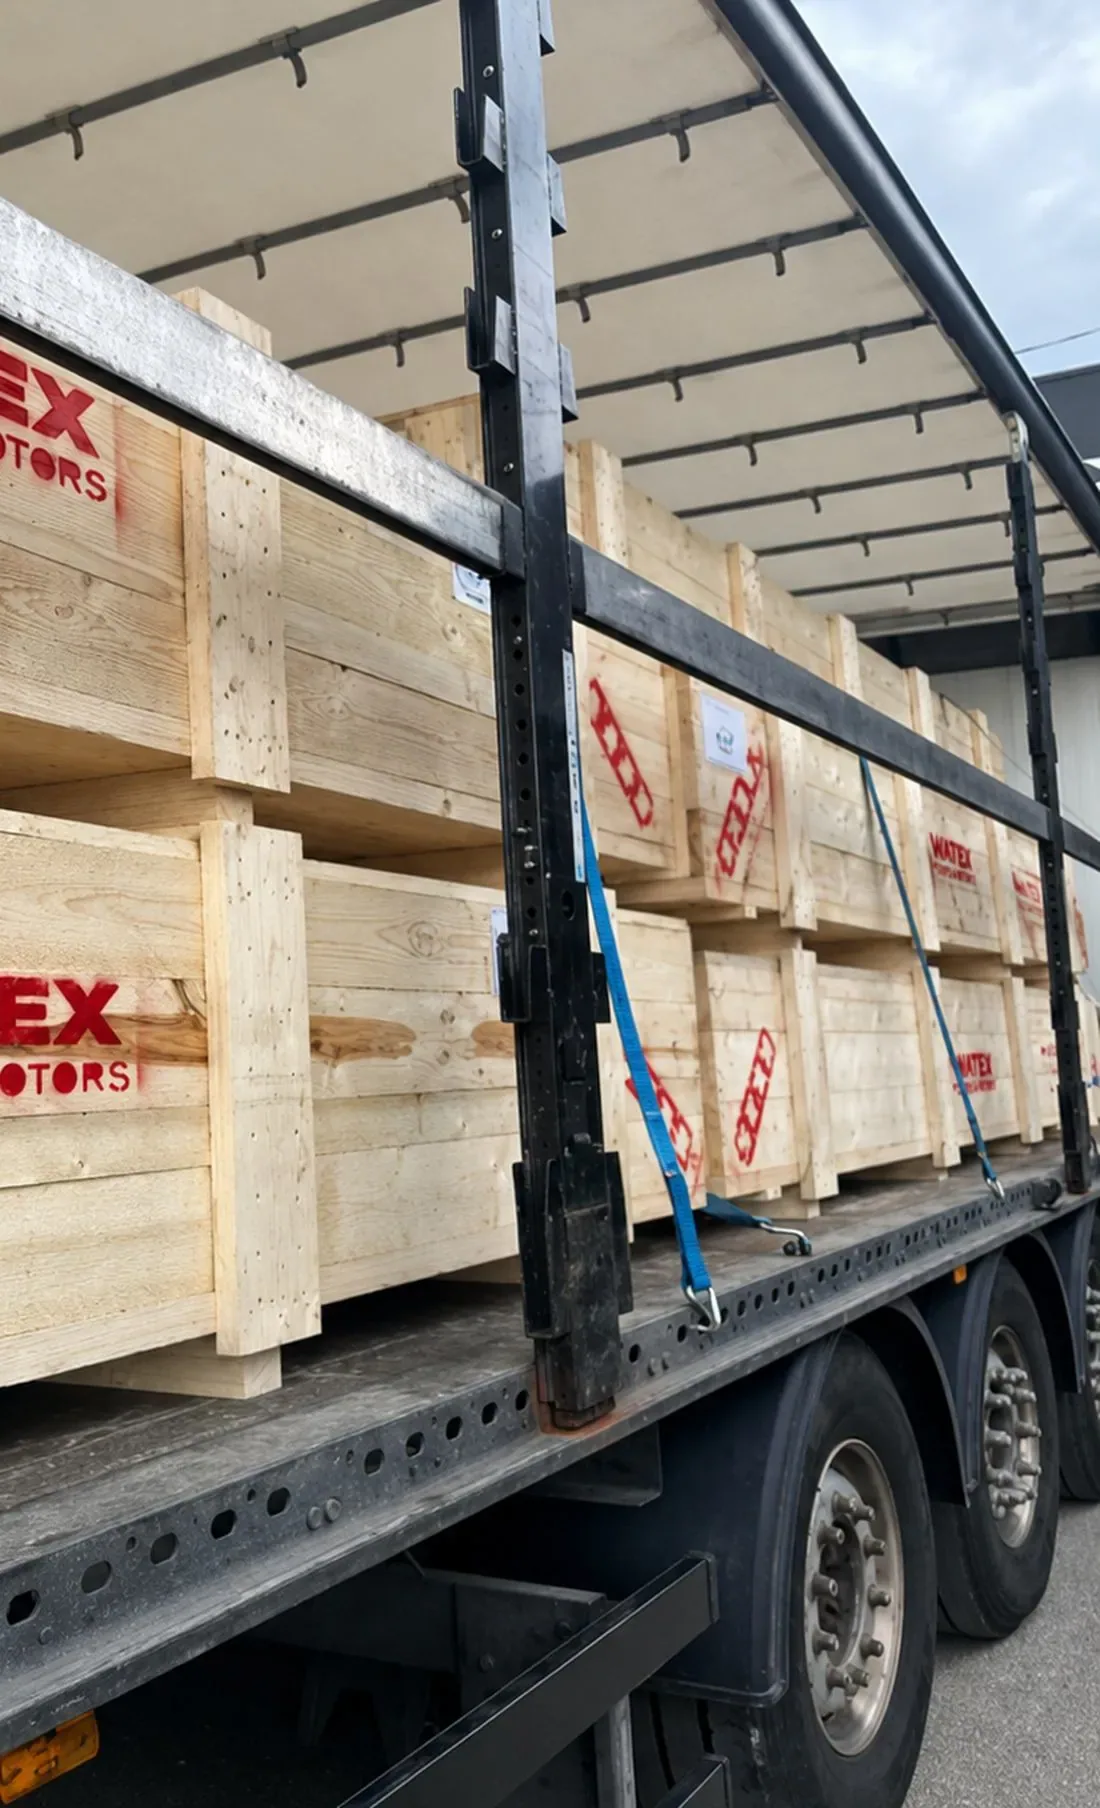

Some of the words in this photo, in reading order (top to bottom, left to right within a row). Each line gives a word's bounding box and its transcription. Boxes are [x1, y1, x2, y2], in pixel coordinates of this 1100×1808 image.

[0, 432, 108, 502] TORS
[928, 831, 973, 871] WATEX
[0, 976, 122, 1046] EX
[0, 1061, 130, 1097] OTORS
